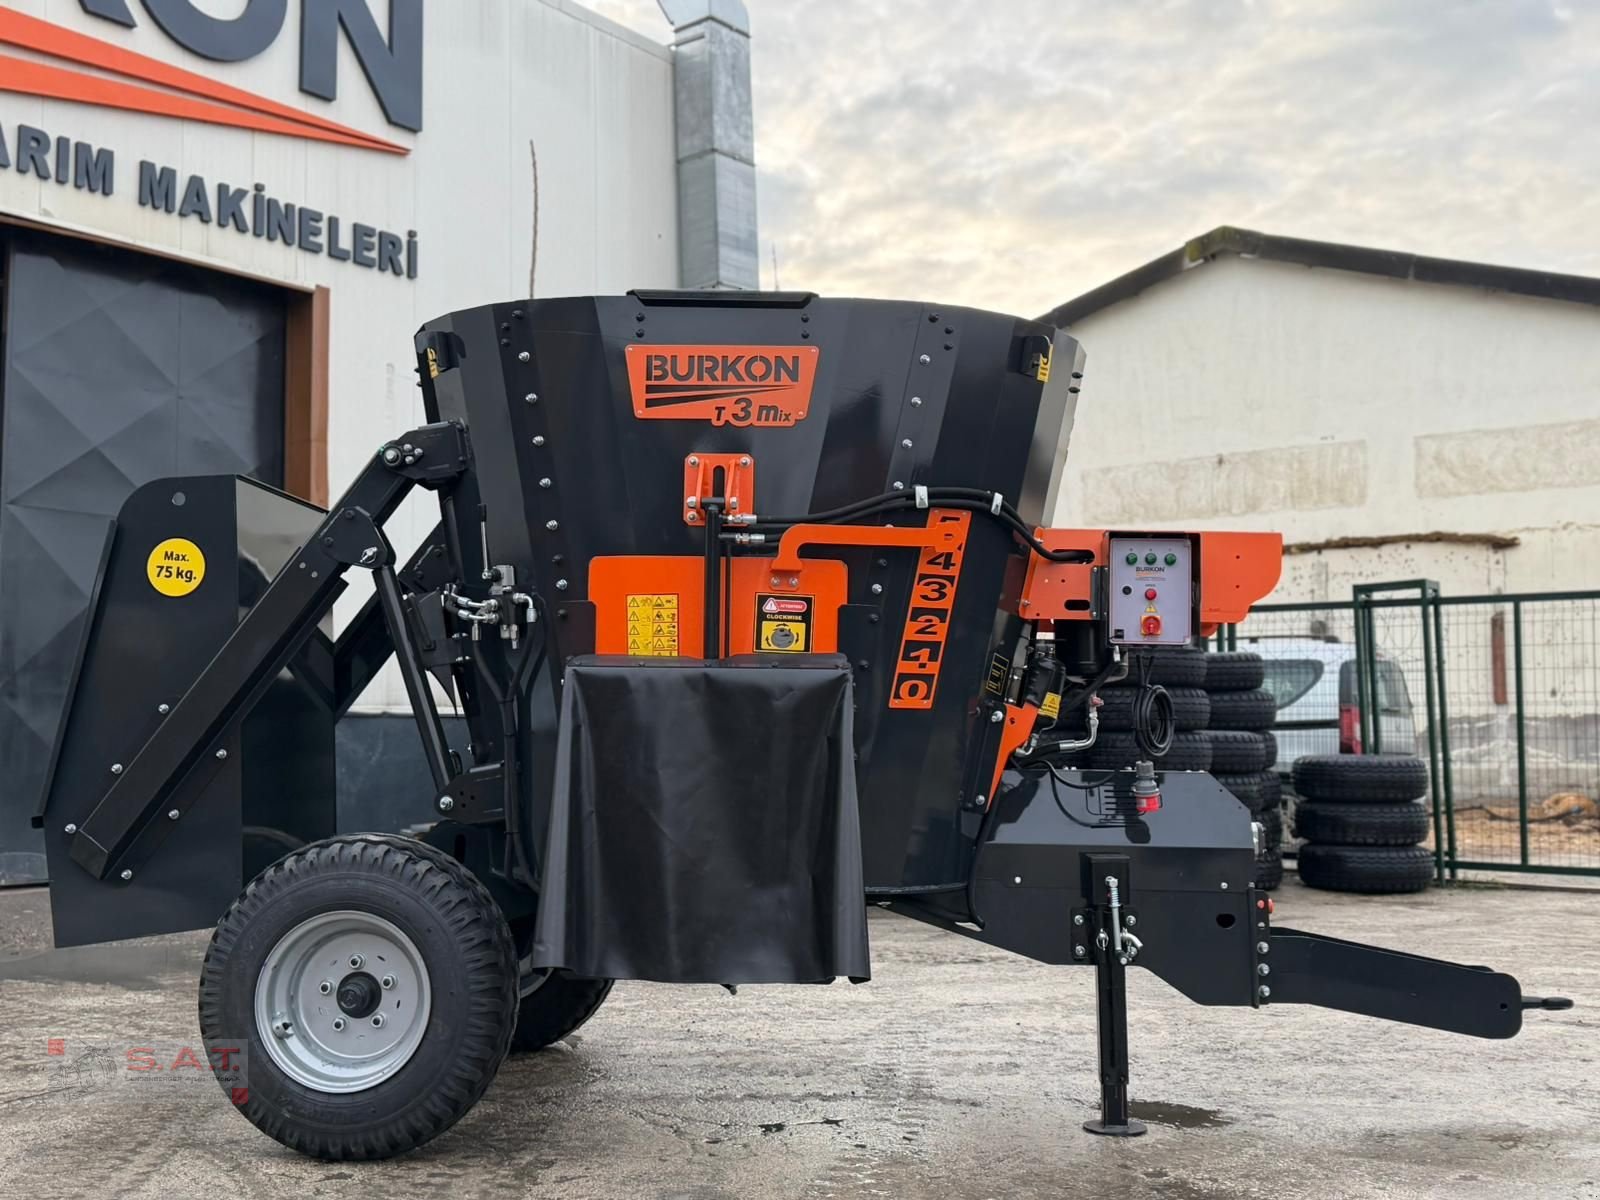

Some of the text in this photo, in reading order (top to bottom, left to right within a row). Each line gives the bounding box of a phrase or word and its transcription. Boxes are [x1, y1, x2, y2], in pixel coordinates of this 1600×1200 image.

[138, 160, 418, 279] MAKİNELERİ
[645, 354, 800, 382] BURKON
[164, 551, 190, 562] Max.
[156, 565, 197, 583] 75 kg.
[919, 577, 948, 602] 3
[914, 615, 941, 636] 2
[910, 648, 931, 669] 1
[898, 679, 929, 701] 0
